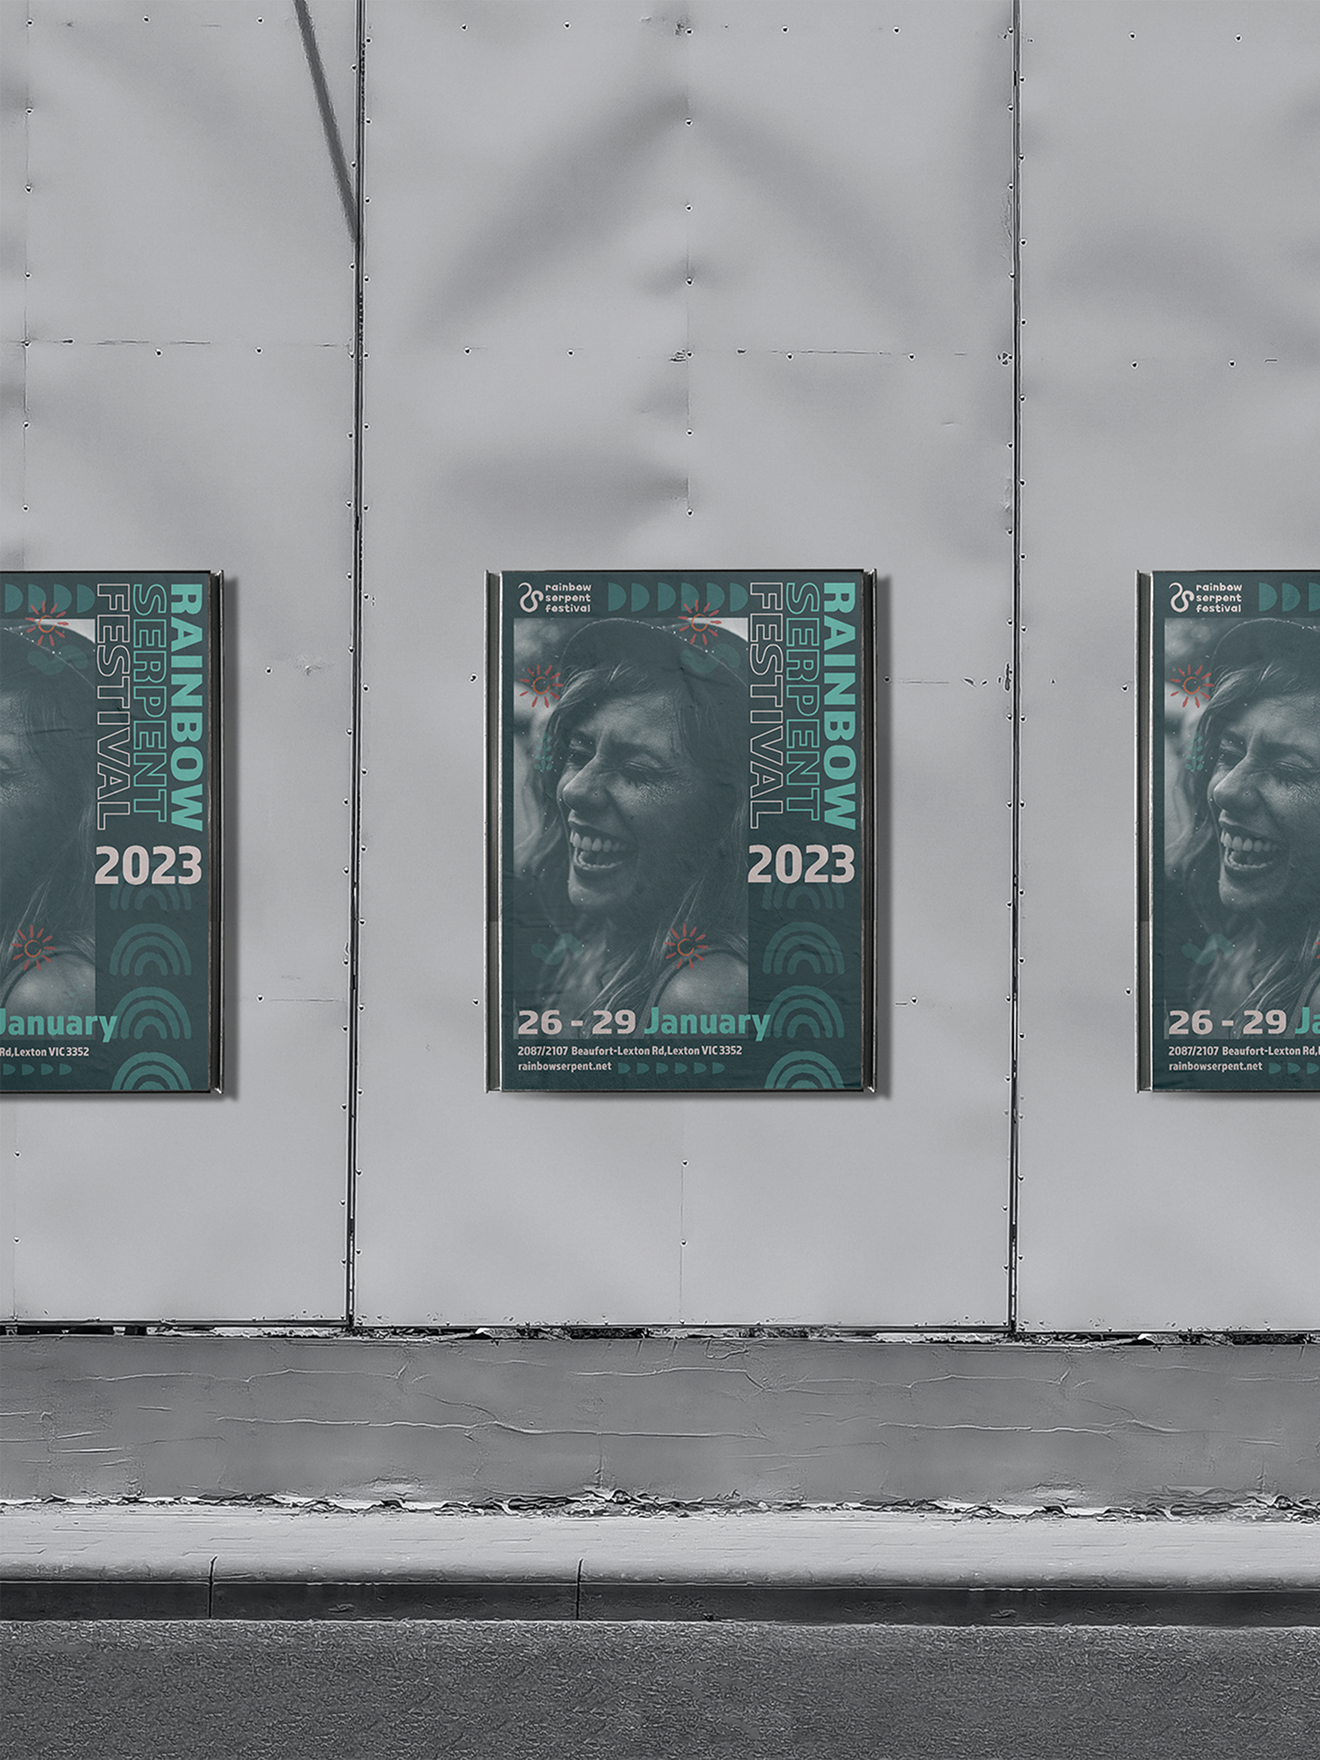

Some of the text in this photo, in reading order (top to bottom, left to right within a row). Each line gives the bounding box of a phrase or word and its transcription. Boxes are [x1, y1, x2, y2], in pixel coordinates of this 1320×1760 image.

[545, 582, 592, 592] rainbow
[1196, 582, 1243, 592] rainbow
[545, 593, 591, 604] serpent
[1196, 593, 1242, 604] serpent
[545, 604, 591, 613] festival
[1196, 604, 1242, 613] festival
[97, 583, 131, 830] FESTIVAL
[133, 583, 167, 822] SERPENT
[170, 583, 203, 831] RAINBOW
[750, 582, 784, 829] FESTIVAL
[786, 582, 820, 821] SERPENT
[823, 582, 856, 830] RAINBOW
[94, 845, 203, 885] 2023
[747, 844, 856, 884] 2023
[517, 1009, 563, 1035] 26
[591, 1009, 637, 1035] 29
[644, 1006, 771, 1042] January
[1168, 1009, 1214, 1035] 26
[1242, 1009, 1288, 1035] 29
[48, 1047, 65, 1057] VIC
[66, 1047, 90, 1057] 3352
[517, 1046, 568, 1056] 2087/2107
[571, 1046, 650, 1056] Beaufort-Lexton
[701, 1046, 718, 1056] VIC
[719, 1046, 743, 1056] 3352
[1168, 1046, 1219, 1056] 2087/2107
[1222, 1046, 1301, 1056] Beaufort-Lexton
[518, 1061, 612, 1074] rainbowserpent.net
[1169, 1061, 1263, 1074] rainbowserpent.net
